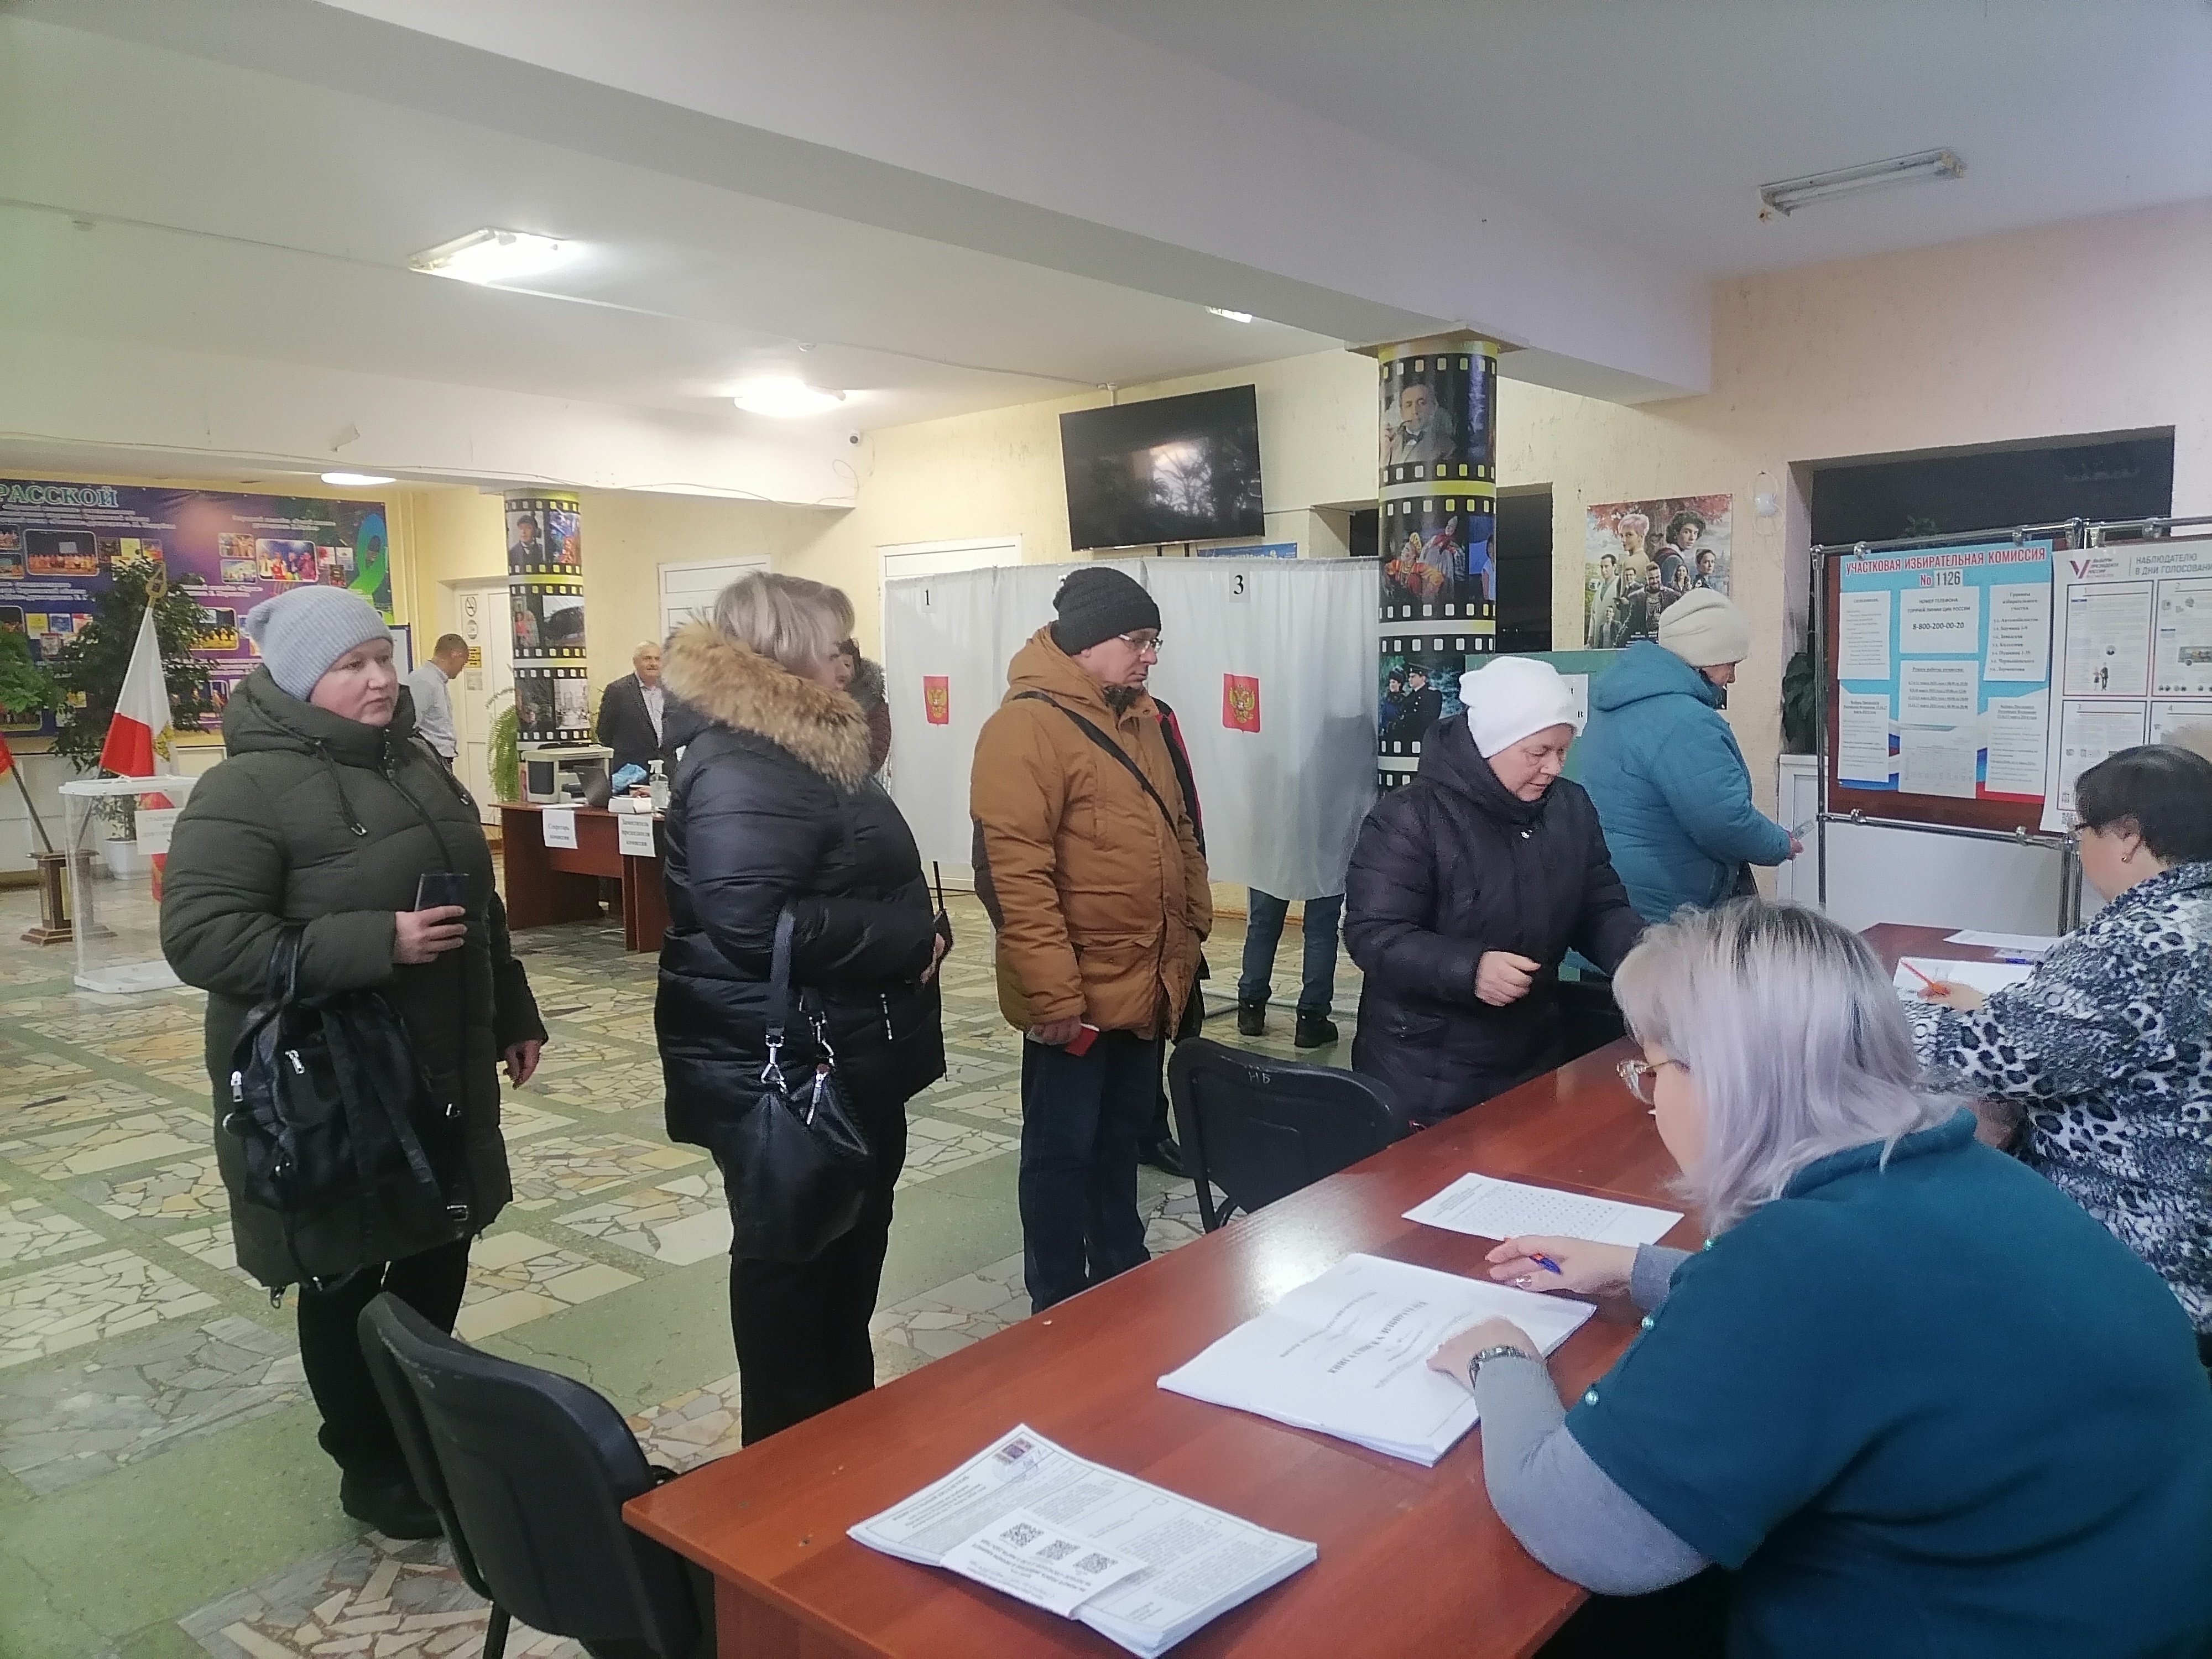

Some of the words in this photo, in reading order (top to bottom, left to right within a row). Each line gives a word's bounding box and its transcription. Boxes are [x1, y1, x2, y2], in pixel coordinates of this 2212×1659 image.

[1846, 559, 1901, 575] УЧАСТКОВАЯ
[1905, 552, 1984, 570] ИЗБИРАТЕЛЬНАЯ
[1989, 547, 2045, 563] КОМИССИЯ
[2136, 553, 2197, 564] НАБЛЮДАТЕЛЮ
[1936, 571, 1960, 586] 1126
[2142, 566, 2158, 575] ДНИ
[1234, 575, 1244, 594] 3
[925, 589, 930, 606] 1
